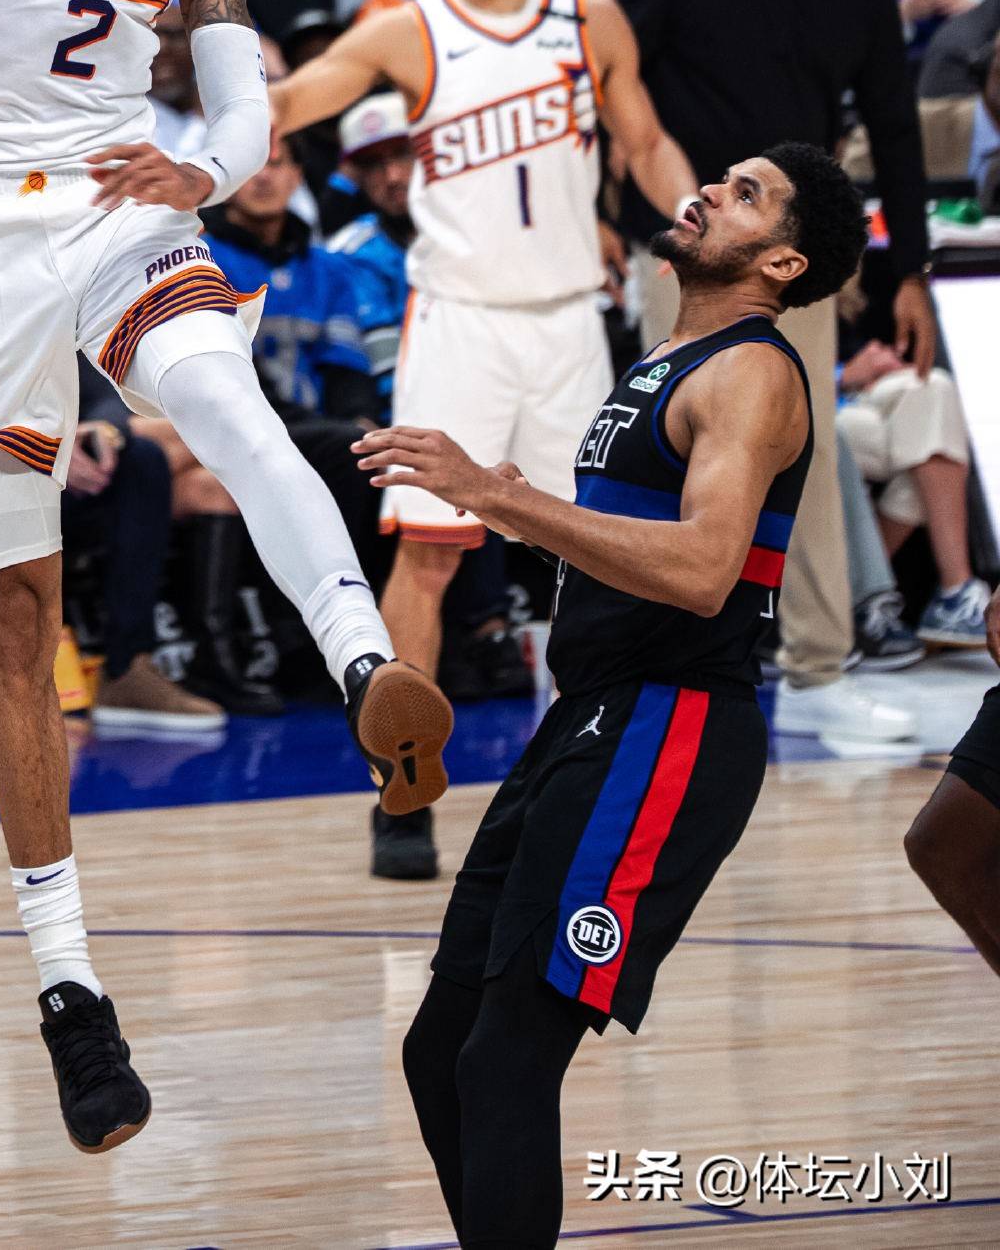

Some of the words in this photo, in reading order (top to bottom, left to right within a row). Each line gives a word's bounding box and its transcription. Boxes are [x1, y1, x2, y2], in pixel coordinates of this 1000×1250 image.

[431, 85, 570, 178] SUNS
[516, 162, 532, 228] 1
[574, 403, 641, 469] ET
[578, 919, 614, 949] DET
